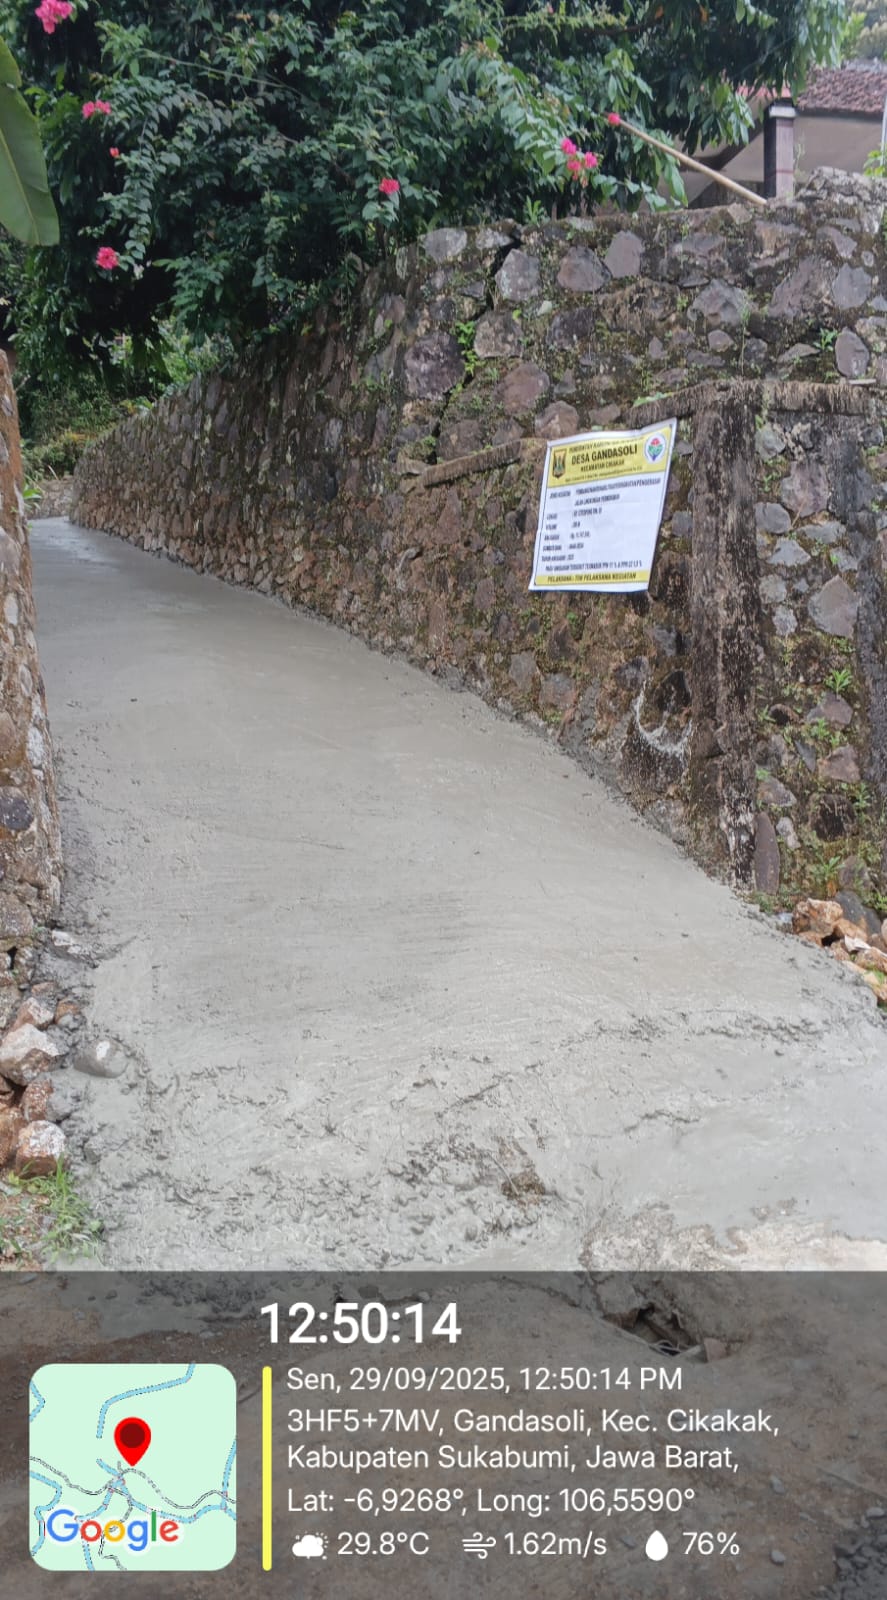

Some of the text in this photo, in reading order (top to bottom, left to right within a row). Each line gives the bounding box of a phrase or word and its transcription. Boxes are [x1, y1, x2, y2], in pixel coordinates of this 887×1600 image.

[571, 444, 638, 465] DESA GANDASOLI
[583, 573, 611, 581] PELAKSANA
